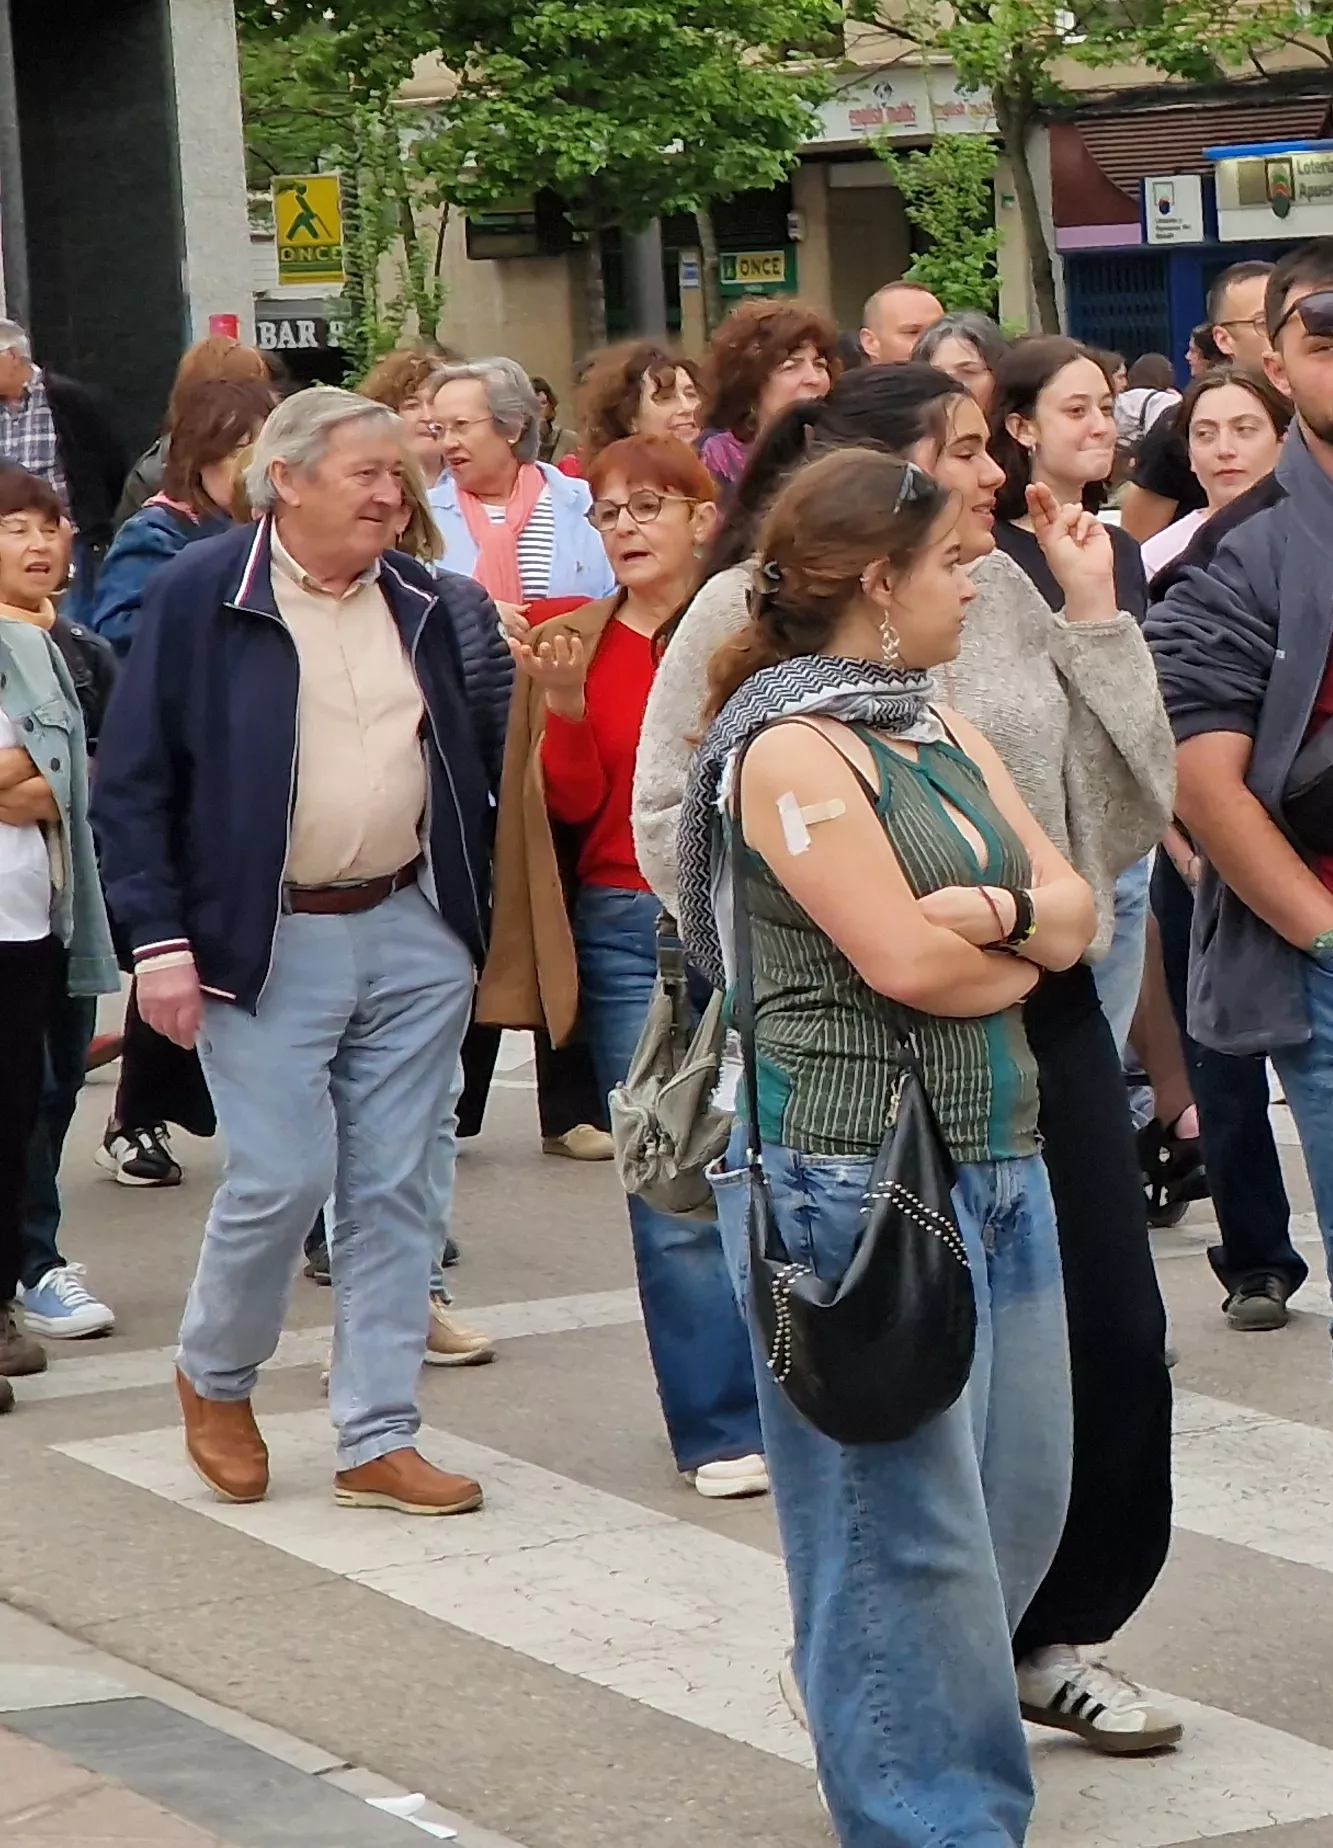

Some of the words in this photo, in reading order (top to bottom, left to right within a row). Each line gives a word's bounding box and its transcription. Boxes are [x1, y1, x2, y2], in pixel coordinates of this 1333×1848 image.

[280, 246, 342, 262] ONCE
[740, 257, 781, 276] ONCE
[257, 320, 318, 350] BAR
